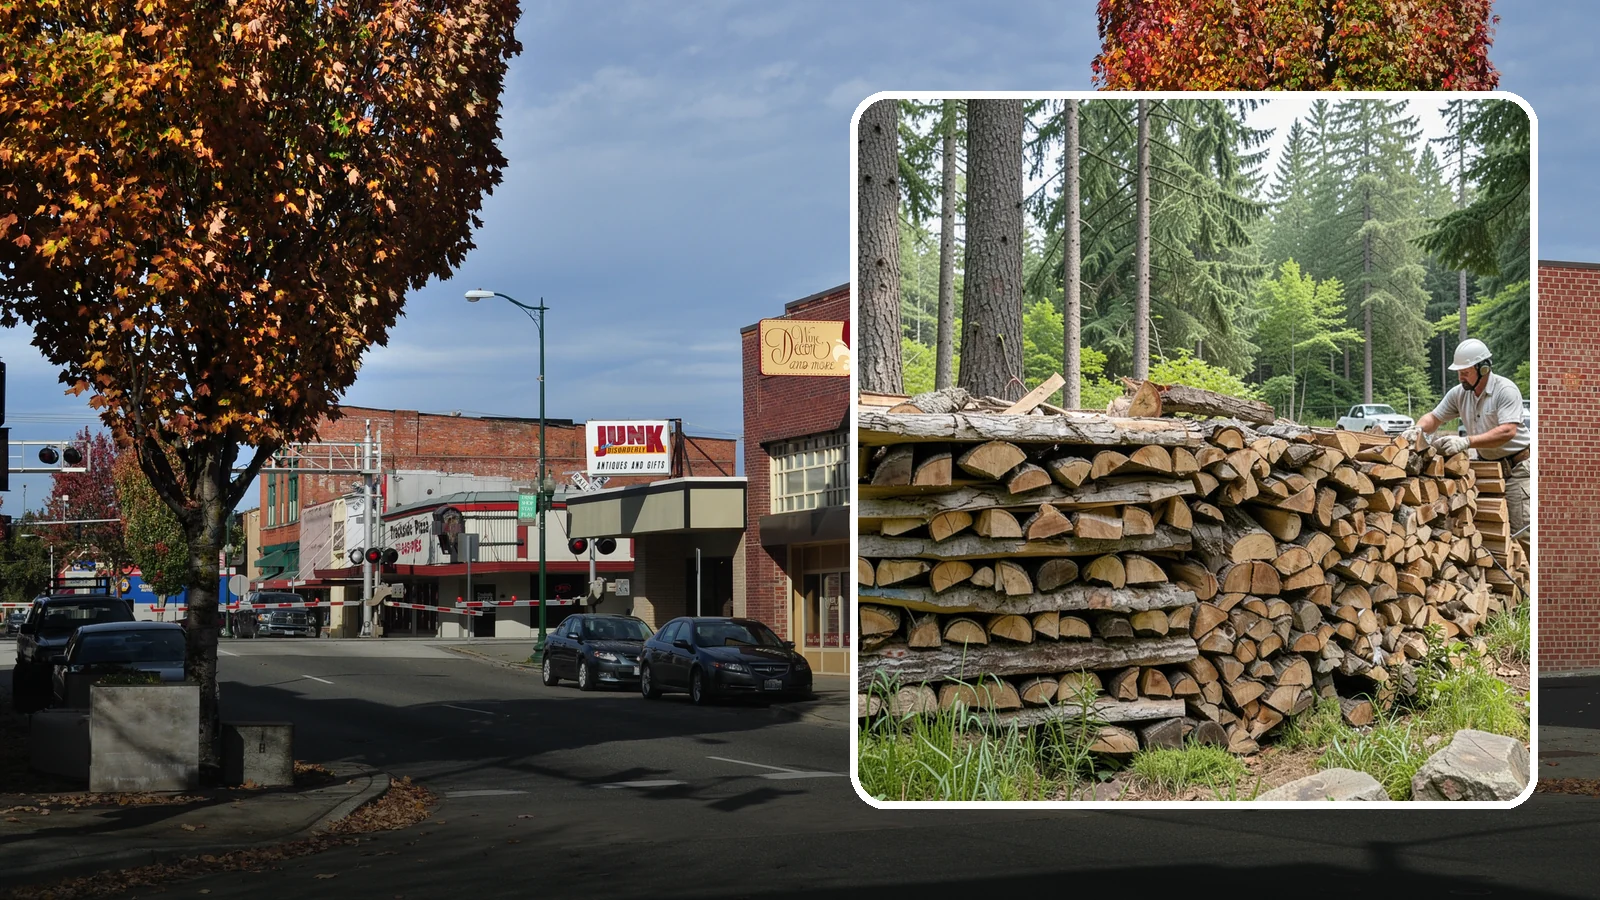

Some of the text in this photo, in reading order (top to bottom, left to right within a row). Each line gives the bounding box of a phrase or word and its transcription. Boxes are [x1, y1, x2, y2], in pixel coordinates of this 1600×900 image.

[596, 425, 664, 457] JUNK
[607, 446, 646, 454] DISORDERLY
[596, 460, 666, 470] ANTIQUES AND GIFTS
[414, 519, 429, 535] Pizza
